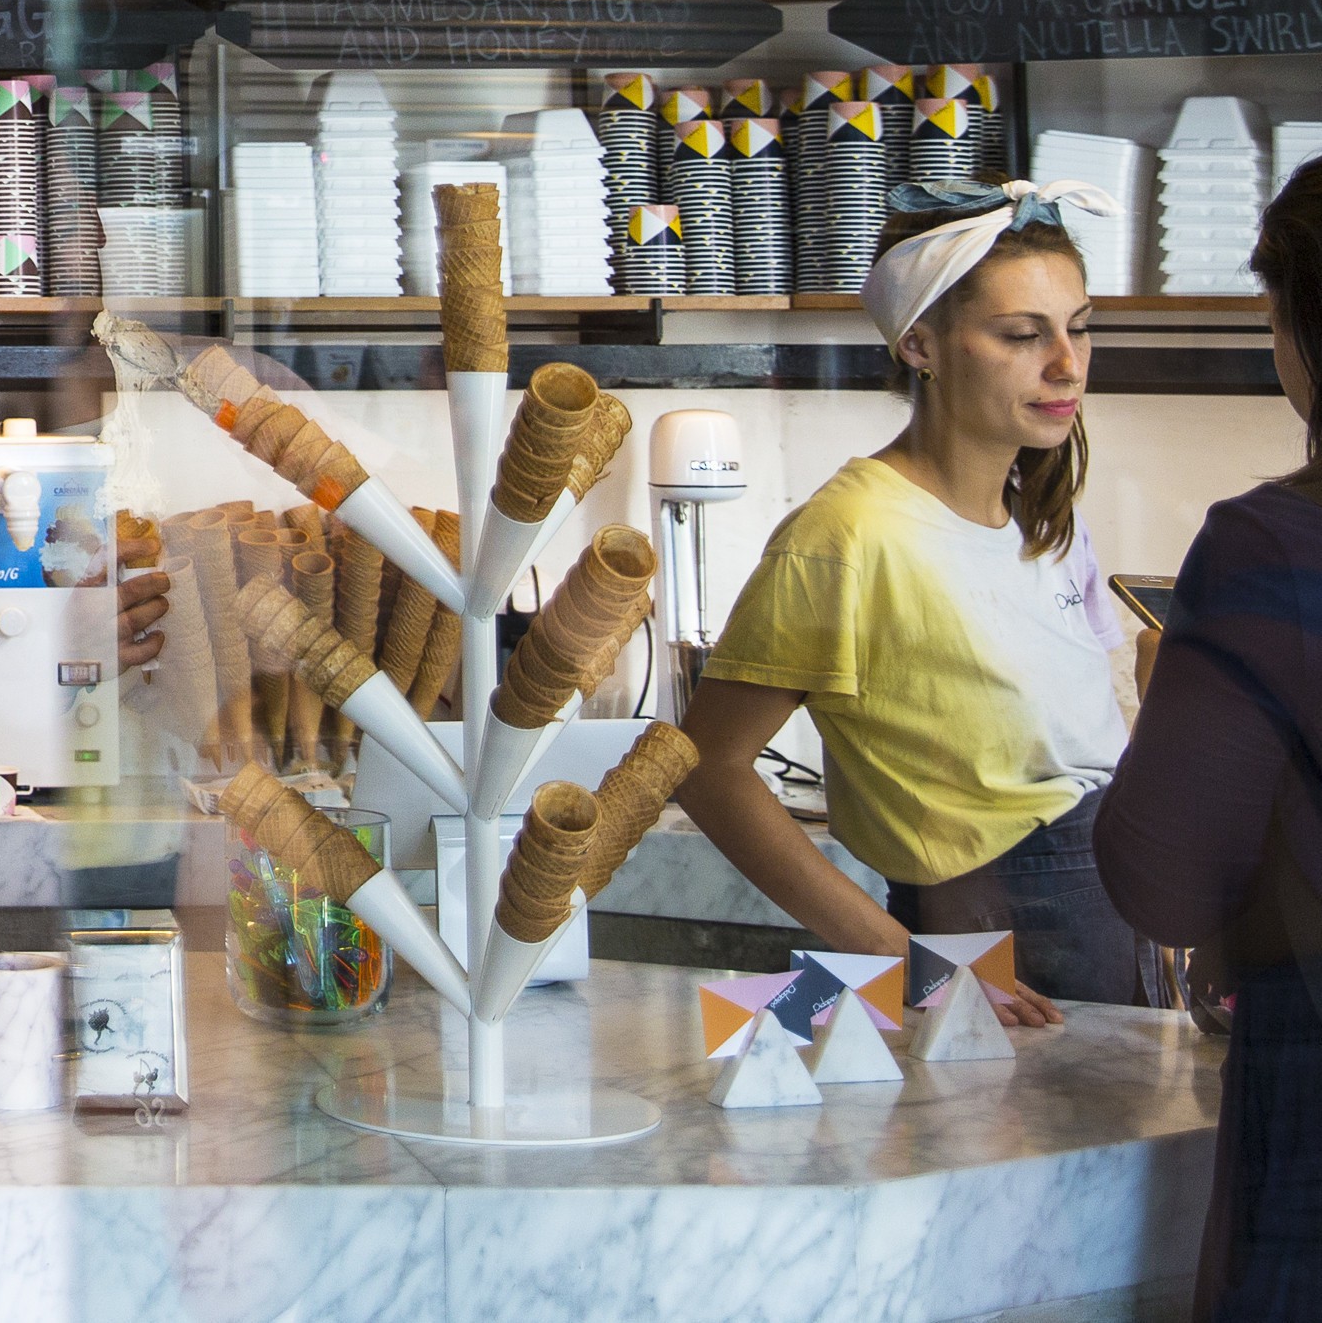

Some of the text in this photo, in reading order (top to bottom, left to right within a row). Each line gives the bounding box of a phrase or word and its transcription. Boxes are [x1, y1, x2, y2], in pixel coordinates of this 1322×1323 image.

[337, 26, 421, 65] AND
[446, 25, 588, 64] HONEY
[908, 12, 1322, 64] AND NUTELLA SWIRL
